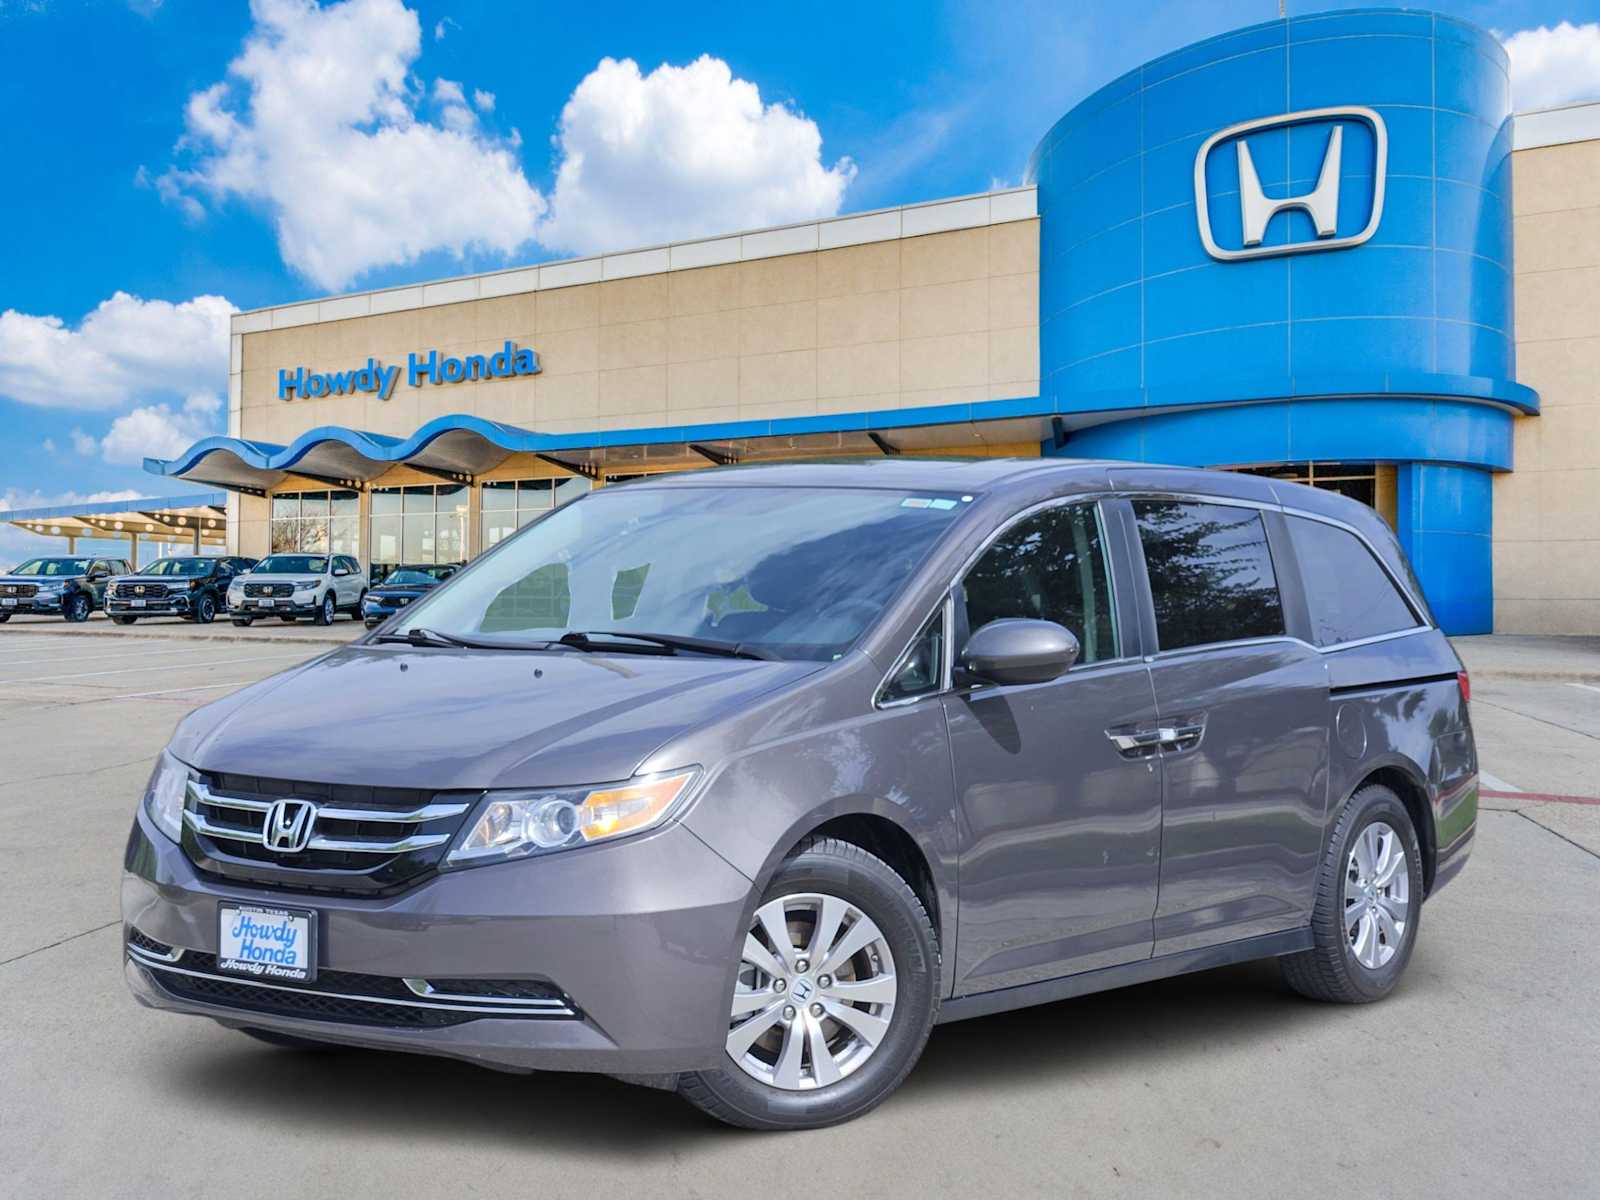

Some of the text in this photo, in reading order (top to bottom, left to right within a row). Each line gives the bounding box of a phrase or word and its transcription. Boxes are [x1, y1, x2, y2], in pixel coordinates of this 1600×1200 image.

[278, 340, 541, 401] Howdy Honda
[232, 915, 298, 948] Howdy
[239, 938, 297, 965] Honda
[220, 959, 307, 979] Howdy Honda
